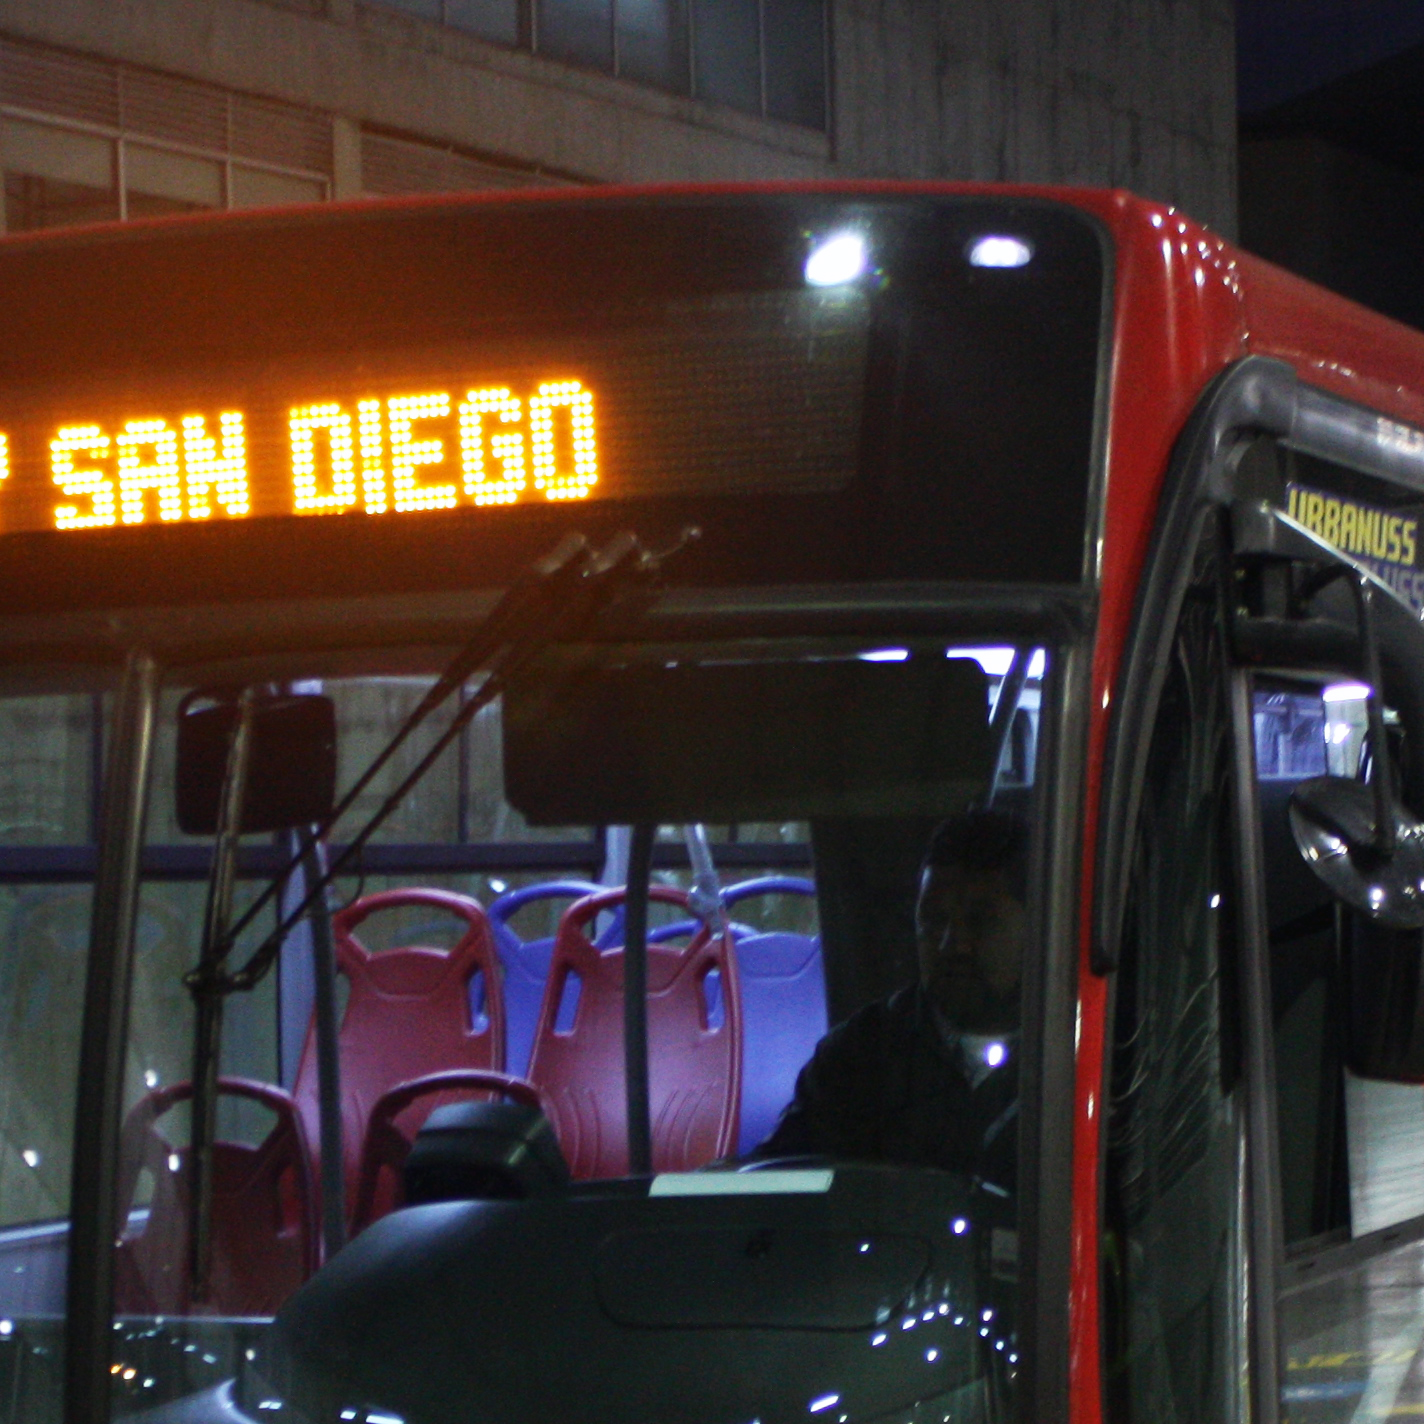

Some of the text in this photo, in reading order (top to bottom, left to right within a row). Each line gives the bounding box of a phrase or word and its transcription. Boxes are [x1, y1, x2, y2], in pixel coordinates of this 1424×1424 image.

[50, 410, 249, 531] SAN
[289, 379, 598, 515] DIEGO
[1288, 487, 1418, 567] URBANUSS
